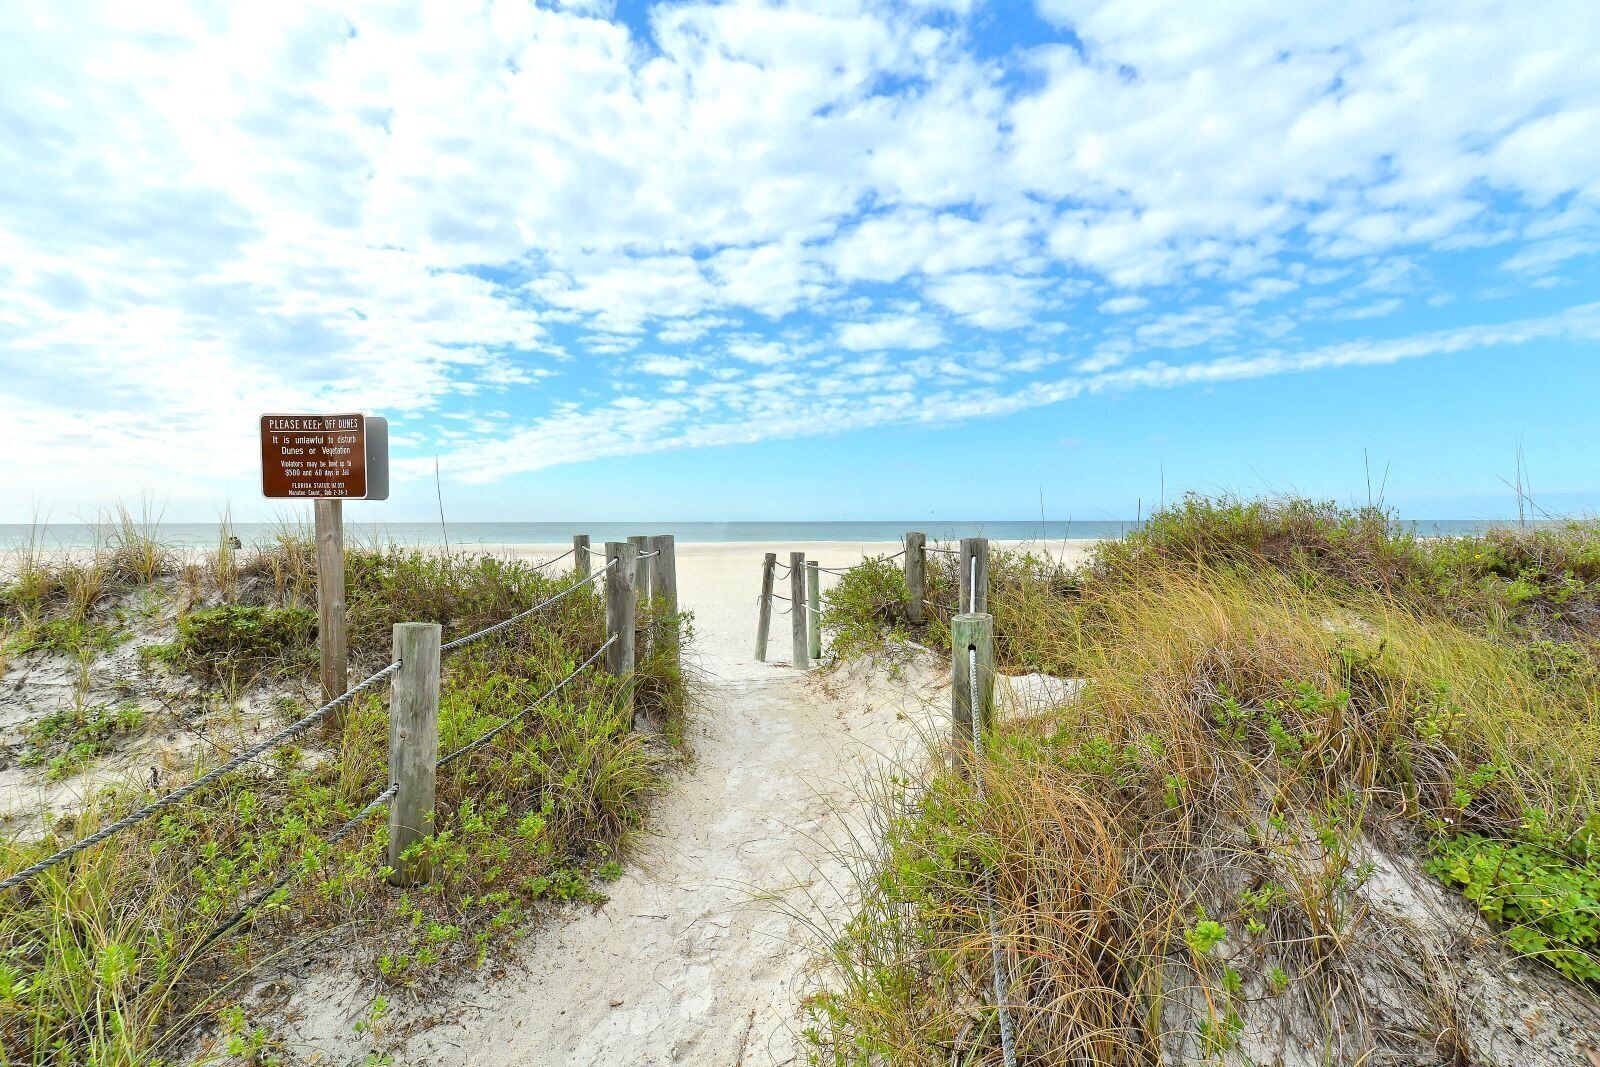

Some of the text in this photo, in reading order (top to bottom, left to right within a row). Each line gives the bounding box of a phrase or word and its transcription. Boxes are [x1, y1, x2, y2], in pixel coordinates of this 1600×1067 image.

[269, 419, 300, 429] PLEASE
[324, 419, 336, 429] OFF
[338, 418, 358, 429] DUNES
[272, 435, 356, 444] It is unlawful to disturb
[281, 446, 304, 455] Dunes
[322, 446, 351, 456] Vegetation
[284, 469, 301, 477] $500
